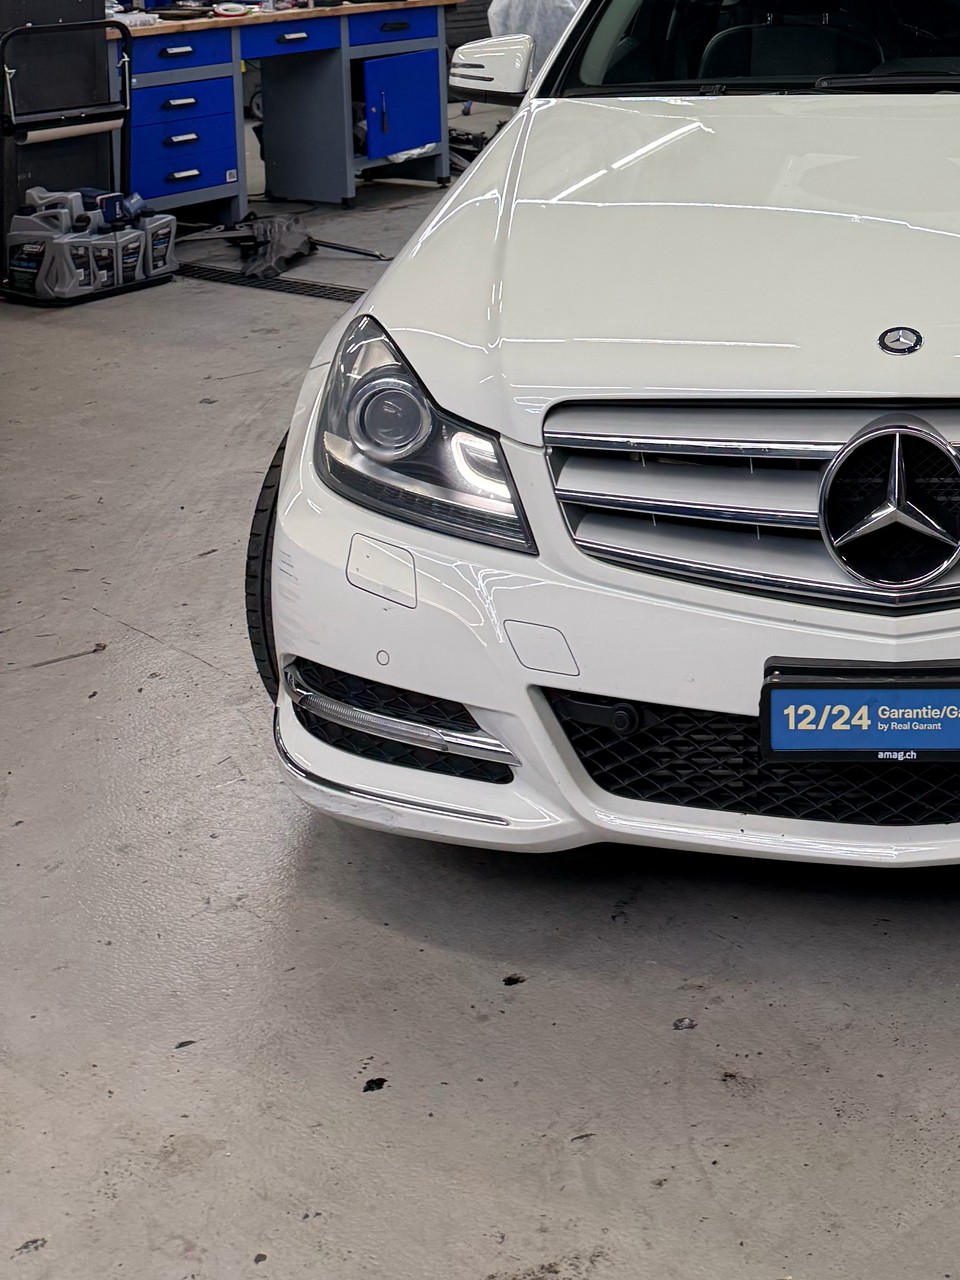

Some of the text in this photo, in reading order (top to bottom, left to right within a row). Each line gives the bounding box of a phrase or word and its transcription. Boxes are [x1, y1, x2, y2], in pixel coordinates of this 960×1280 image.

[783, 704, 872, 730] 12/24
[877, 722, 942, 731] by Real Garant
[877, 750, 917, 761] amag.ch
